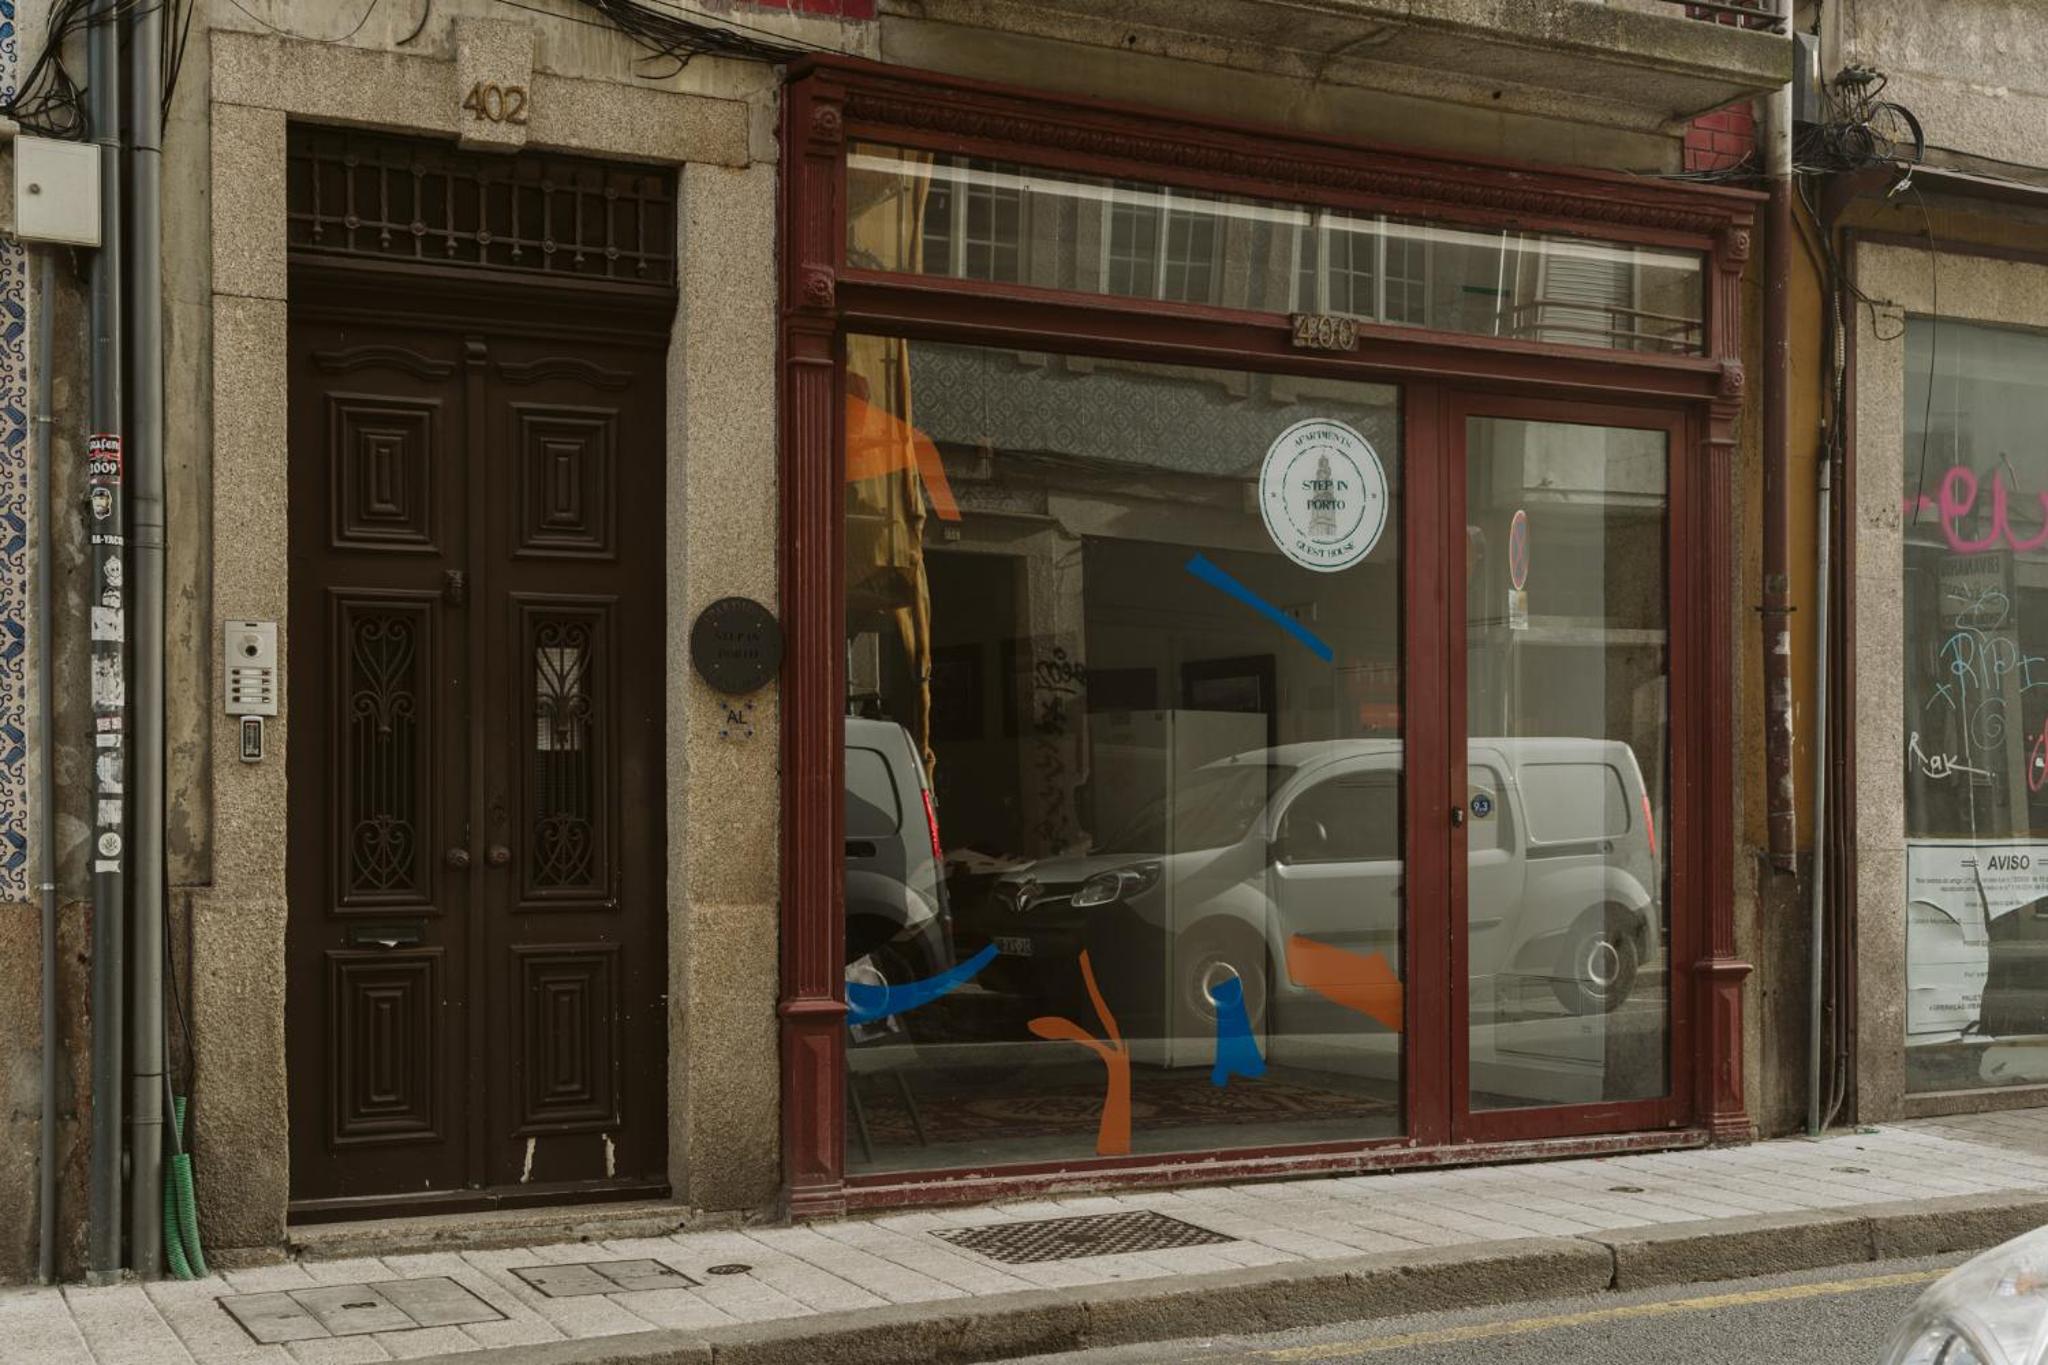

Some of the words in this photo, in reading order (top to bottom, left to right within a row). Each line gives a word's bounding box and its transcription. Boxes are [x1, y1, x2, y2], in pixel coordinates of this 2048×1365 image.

[462, 80, 527, 125] 402
[1297, 317, 1355, 351] 400
[1294, 430, 1352, 449] APARTMENTS
[1302, 479, 1333, 491] STEP
[1337, 479, 1348, 491] IN
[1307, 499, 1346, 511] PORTO
[1296, 540, 1324, 558] GUEST
[727, 709, 747, 725] AL
[1987, 854, 2030, 871] AVISO
